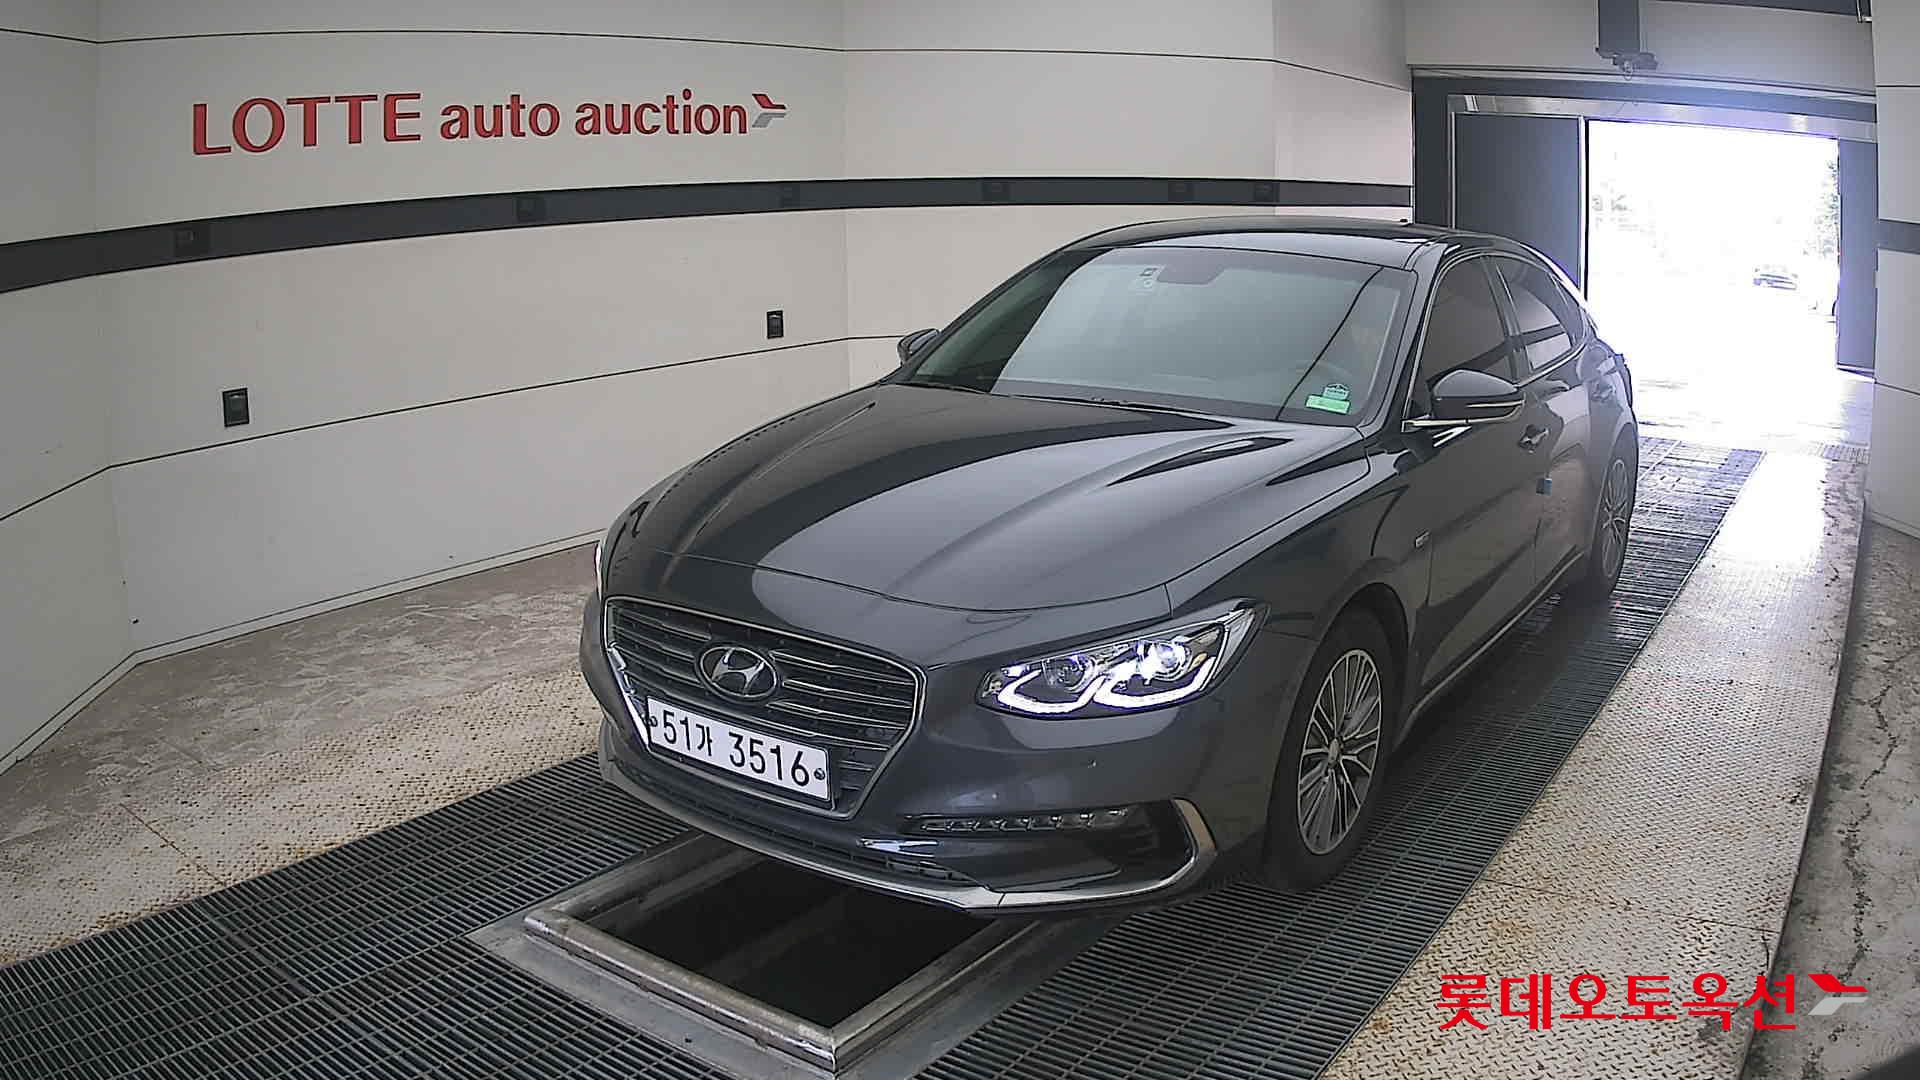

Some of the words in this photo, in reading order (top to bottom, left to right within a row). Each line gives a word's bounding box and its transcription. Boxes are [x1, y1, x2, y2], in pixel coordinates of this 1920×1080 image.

[193, 93, 422, 156] LOTTE
[439, 93, 560, 140] auto
[574, 88, 748, 136] auction
[662, 709, 713, 757] 51가
[728, 731, 810, 787] 3516
